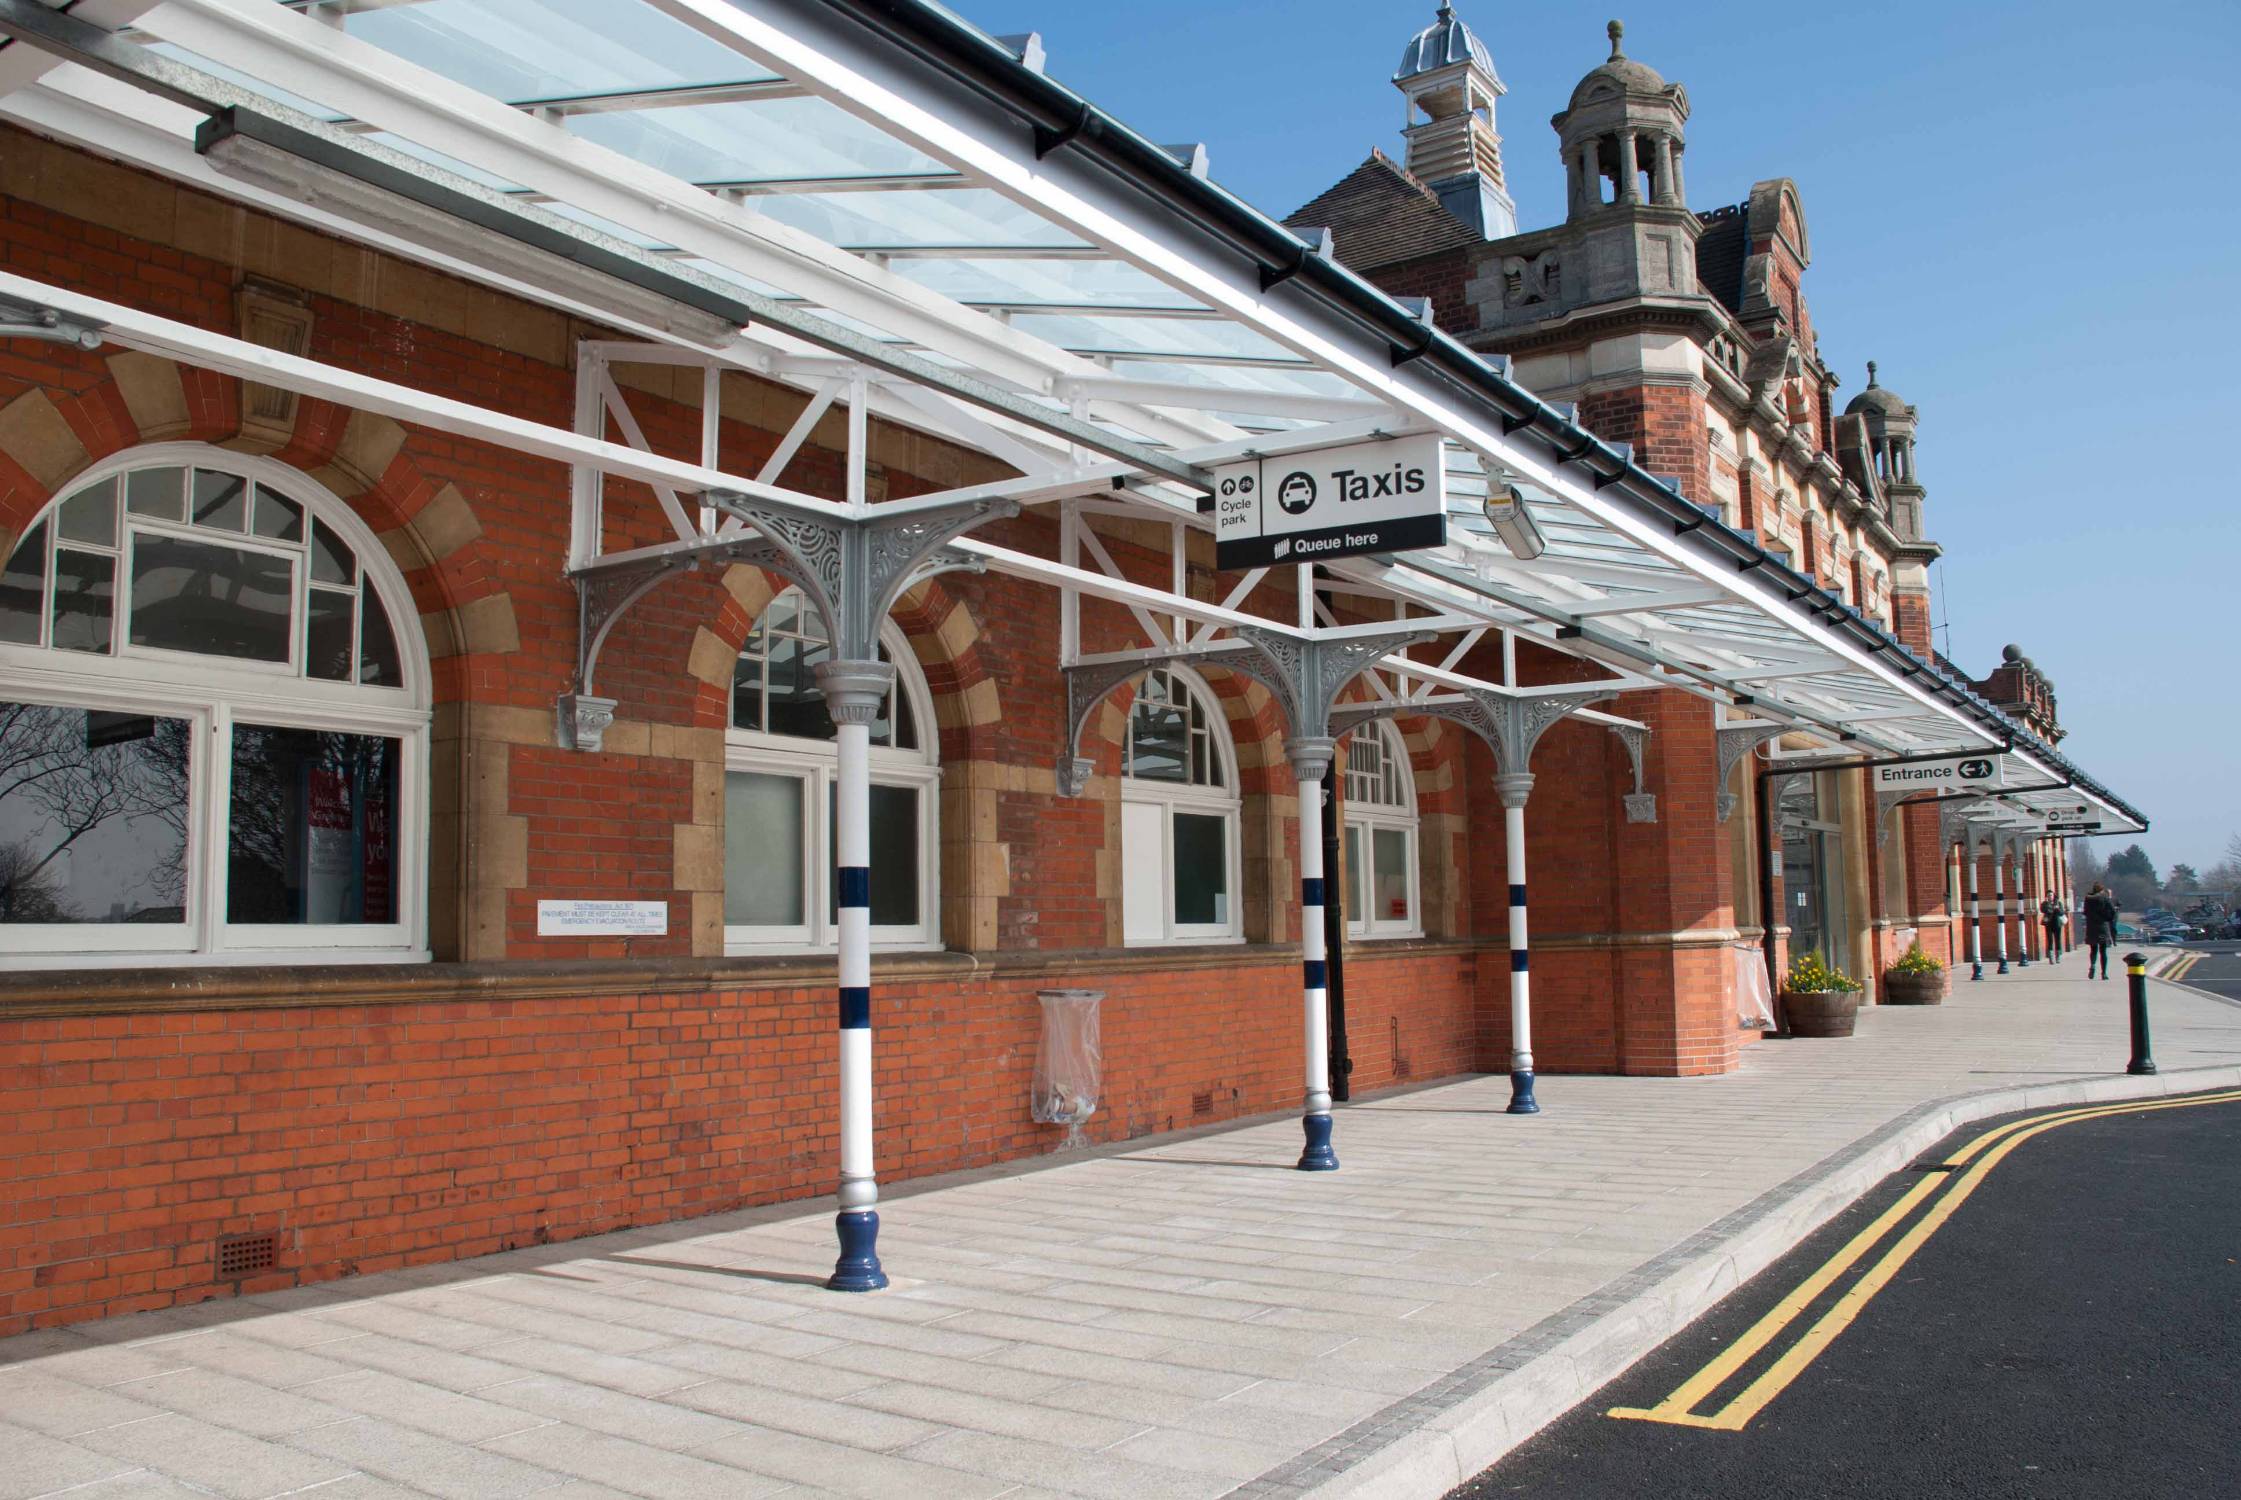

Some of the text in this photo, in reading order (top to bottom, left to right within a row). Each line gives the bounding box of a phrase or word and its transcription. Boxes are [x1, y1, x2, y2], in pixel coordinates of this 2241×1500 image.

[1331, 463, 1425, 502] Taxis
[1221, 499, 1251, 512] Cycle
[1221, 513, 1247, 528] park
[1295, 533, 1379, 553] Queue here
[1882, 767, 1952, 781] Entrance
